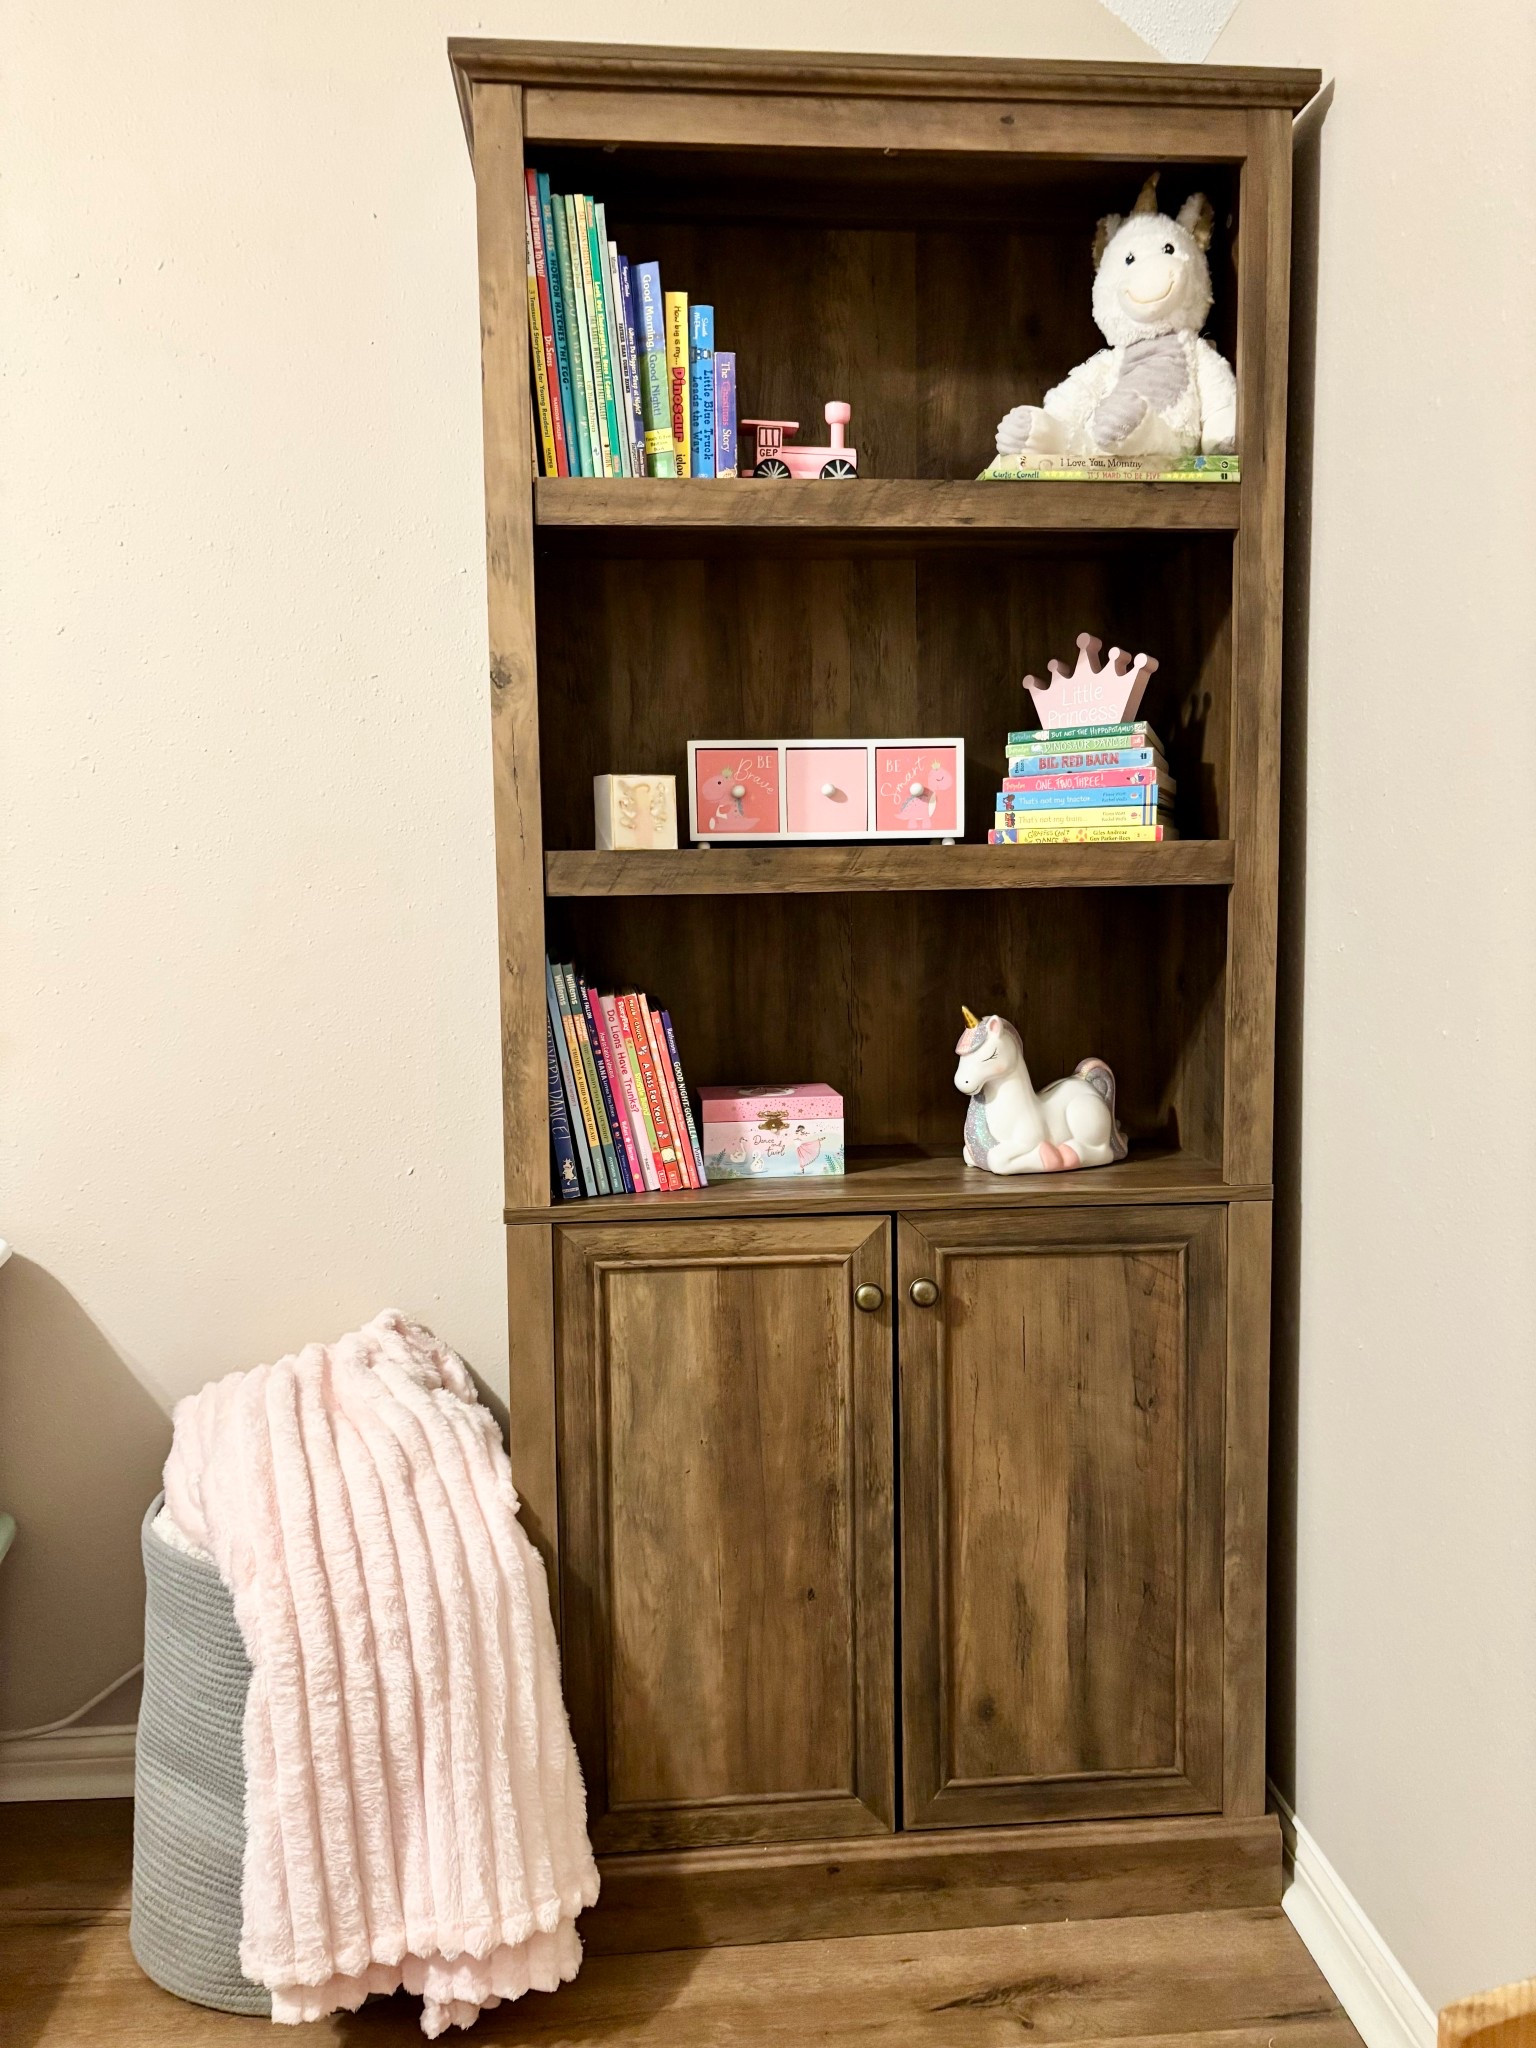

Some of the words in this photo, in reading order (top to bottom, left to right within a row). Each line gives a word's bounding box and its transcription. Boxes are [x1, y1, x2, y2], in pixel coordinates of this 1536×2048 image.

[529, 195, 539, 216] HAPPY
[531, 217, 543, 250] BIRTHDAY
[546, 224, 555, 251] SEUSS
[550, 259, 560, 298] HORTON
[642, 274, 653, 302] Good
[530, 296, 538, 330] Treasured
[554, 302, 565, 341] HATCHES
[643, 306, 657, 351] Morning,
[674, 324, 682, 337] big
[544, 335, 553, 347] Dr.
[532, 332, 543, 371] Storybooks
[545, 347, 555, 367] Seuss
[559, 345, 567, 362] THE
[629, 354, 638, 374] Diggers
[649, 354, 659, 381] Good
[721, 362, 730, 378] The
[561, 366, 569, 383] EGG
[704, 369, 713, 397] Little
[538, 386, 546, 406] Young
[649, 385, 662, 416] Night!
[693, 376, 702, 407] Leads
[633, 397, 641, 415] Night?
[674, 366, 687, 442] Dinosaur
[704, 400, 713, 425] Blue
[722, 381, 732, 425] Christmas
[542, 408, 550, 438] Readers!
[694, 410, 702, 426] the
[692, 431, 702, 454] Way
[704, 429, 714, 460] Truck
[721, 428, 732, 453] Story
[760, 448, 778, 457] GEP
[676, 454, 686, 476] igloo
[1066, 458, 1086, 467] Love
[1089, 458, 1106, 467] You,
[1108, 458, 1143, 468] Mommy
[1062, 682, 1102, 706] Little
[1048, 704, 1118, 729] Princess
[1090, 725, 1134, 736] HIPPOPOTAMUS
[1044, 740, 1090, 752] DINOSAUR
[1093, 737, 1130, 748] DANCE!
[757, 755, 772, 769] BE
[886, 759, 901, 773] BE
[1039, 757, 1058, 770] BIG
[1062, 754, 1084, 768] RED
[1086, 752, 1119, 767] BARN
[734, 758, 774, 794] Brave
[880, 755, 926, 805] Smart
[1036, 779, 1056, 791] ONE,
[1056, 778, 1074, 790] TWO,
[1074, 774, 1104, 789] THREE!
[1018, 796, 1038, 804] That's
[1054, 797, 1066, 805] my
[1018, 815, 1038, 824] That's
[1053, 816, 1064, 824] my
[554, 975, 567, 1006] Willems
[566, 974, 578, 1005] Willems
[584, 1002, 592, 1019] FALLON
[606, 1009, 617, 1022] Do
[618, 1001, 630, 1032] StoryPlay
[610, 1025, 624, 1048] Lions
[633, 1021, 643, 1042] Church
[571, 1048, 581, 1067] THERE
[603, 1047, 611, 1059] Catch
[597, 1060, 608, 1080] NANA
[606, 1061, 615, 1078] Unicorn
[617, 1052, 630, 1075] Have
[673, 1061, 684, 1082] GOOD
[579, 1082, 587, 1095] BIRD
[588, 1069, 598, 1089] READY
[644, 1071, 655, 1088] Kiss
[582, 1097, 589, 1105] ON
[593, 1090, 600, 1099] TO
[623, 1078, 639, 1113] Trunks?
[634, 1072, 646, 1095] Snuggle
[640, 1096, 650, 1116] Bunny
[649, 1090, 659, 1104] For
[678, 1083, 690, 1107] NIGHT,
[549, 1089, 570, 1140] DANCE!
[584, 1106, 593, 1122] YOUR
[595, 1099, 604, 1114] PLAY
[653, 1106, 664, 1125] You!
[588, 1123, 597, 1142] HEAD!
[684, 1107, 698, 1139] GORILLA
[753, 1134, 774, 1146] Dance
[694, 1147, 703, 1166] Putnam
[765, 1144, 786, 1158] twirl
